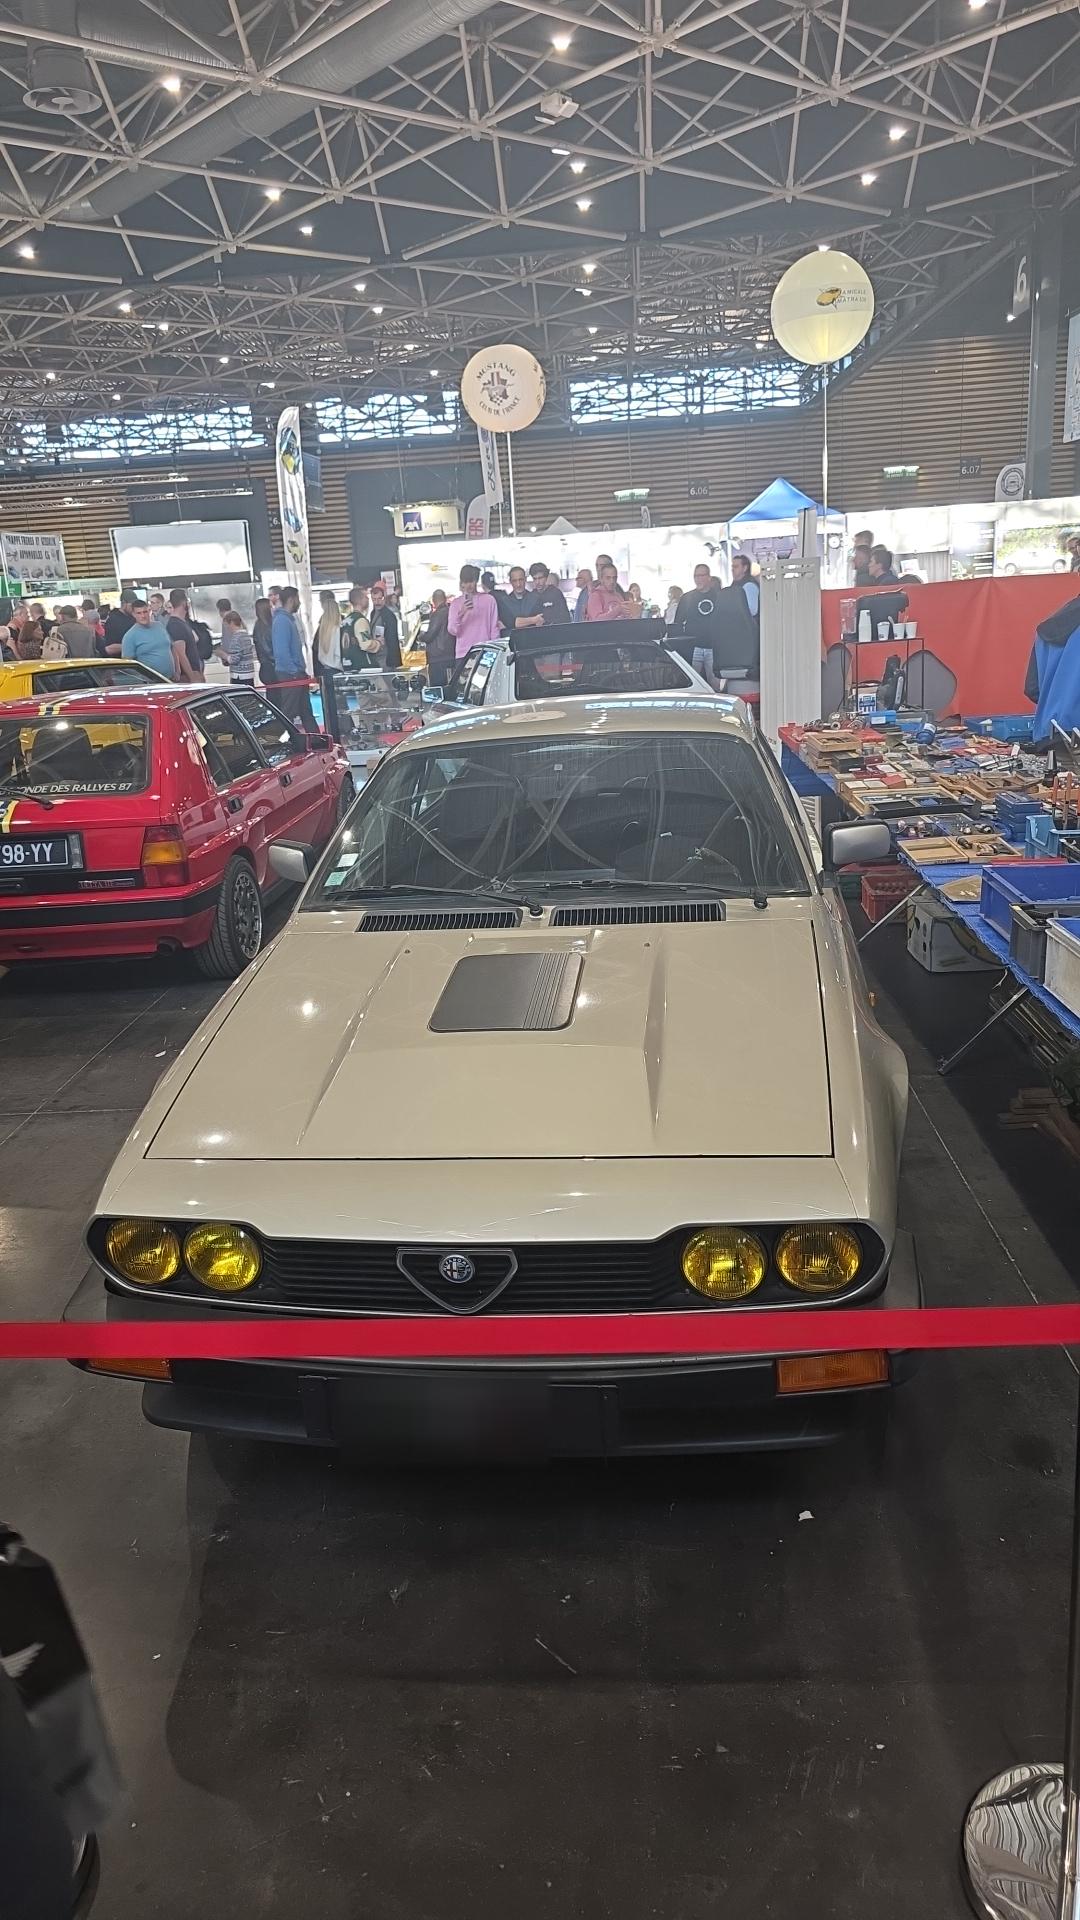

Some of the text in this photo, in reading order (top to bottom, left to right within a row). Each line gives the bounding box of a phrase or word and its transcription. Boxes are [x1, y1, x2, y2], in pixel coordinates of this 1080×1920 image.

[1016, 255, 1027, 302] 6
[476, 362, 516, 379] MUSTANG
[961, 466, 980, 475] 6.07
[690, 487, 708, 495] 6.06
[50, 784, 70, 793] DES
[71, 783, 117, 792] RALLYES
[118, 782, 133, 791] 87
[0, 842, 53, 864] 98-YY
